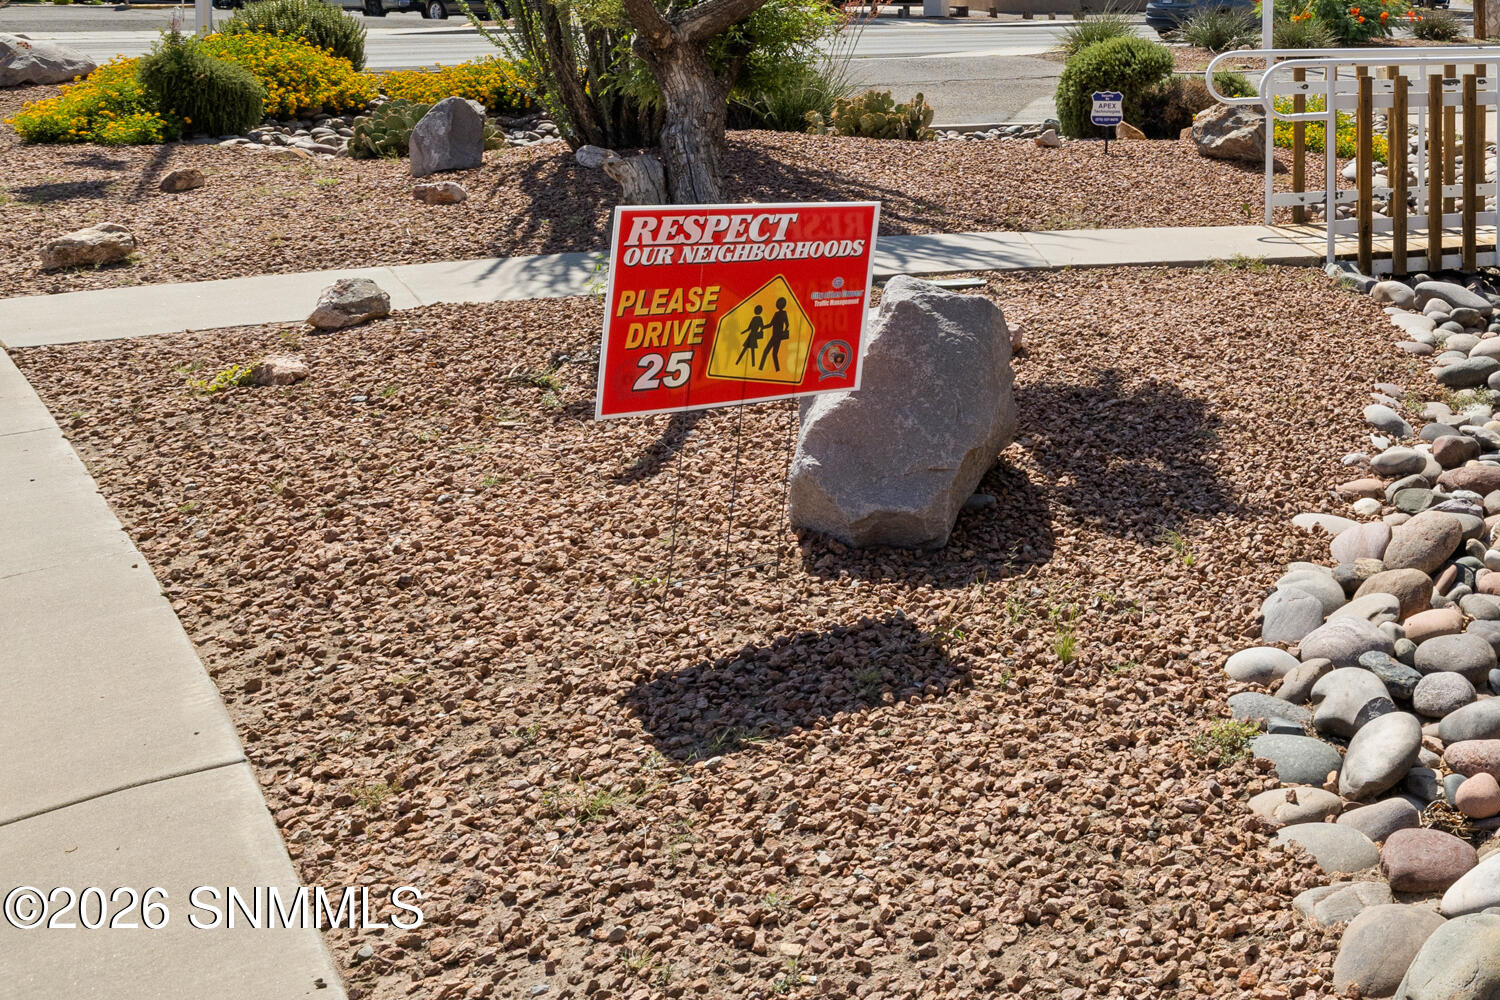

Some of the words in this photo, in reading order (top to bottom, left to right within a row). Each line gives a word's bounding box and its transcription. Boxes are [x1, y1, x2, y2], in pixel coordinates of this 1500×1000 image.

[624, 212, 798, 247] RESPECT
[623, 246, 675, 267] OUR
[678, 239, 866, 265] NEIGHBORHOODS
[616, 285, 721, 318] PLEASE
[624, 318, 707, 351] DRIVE
[632, 350, 695, 392] 25
